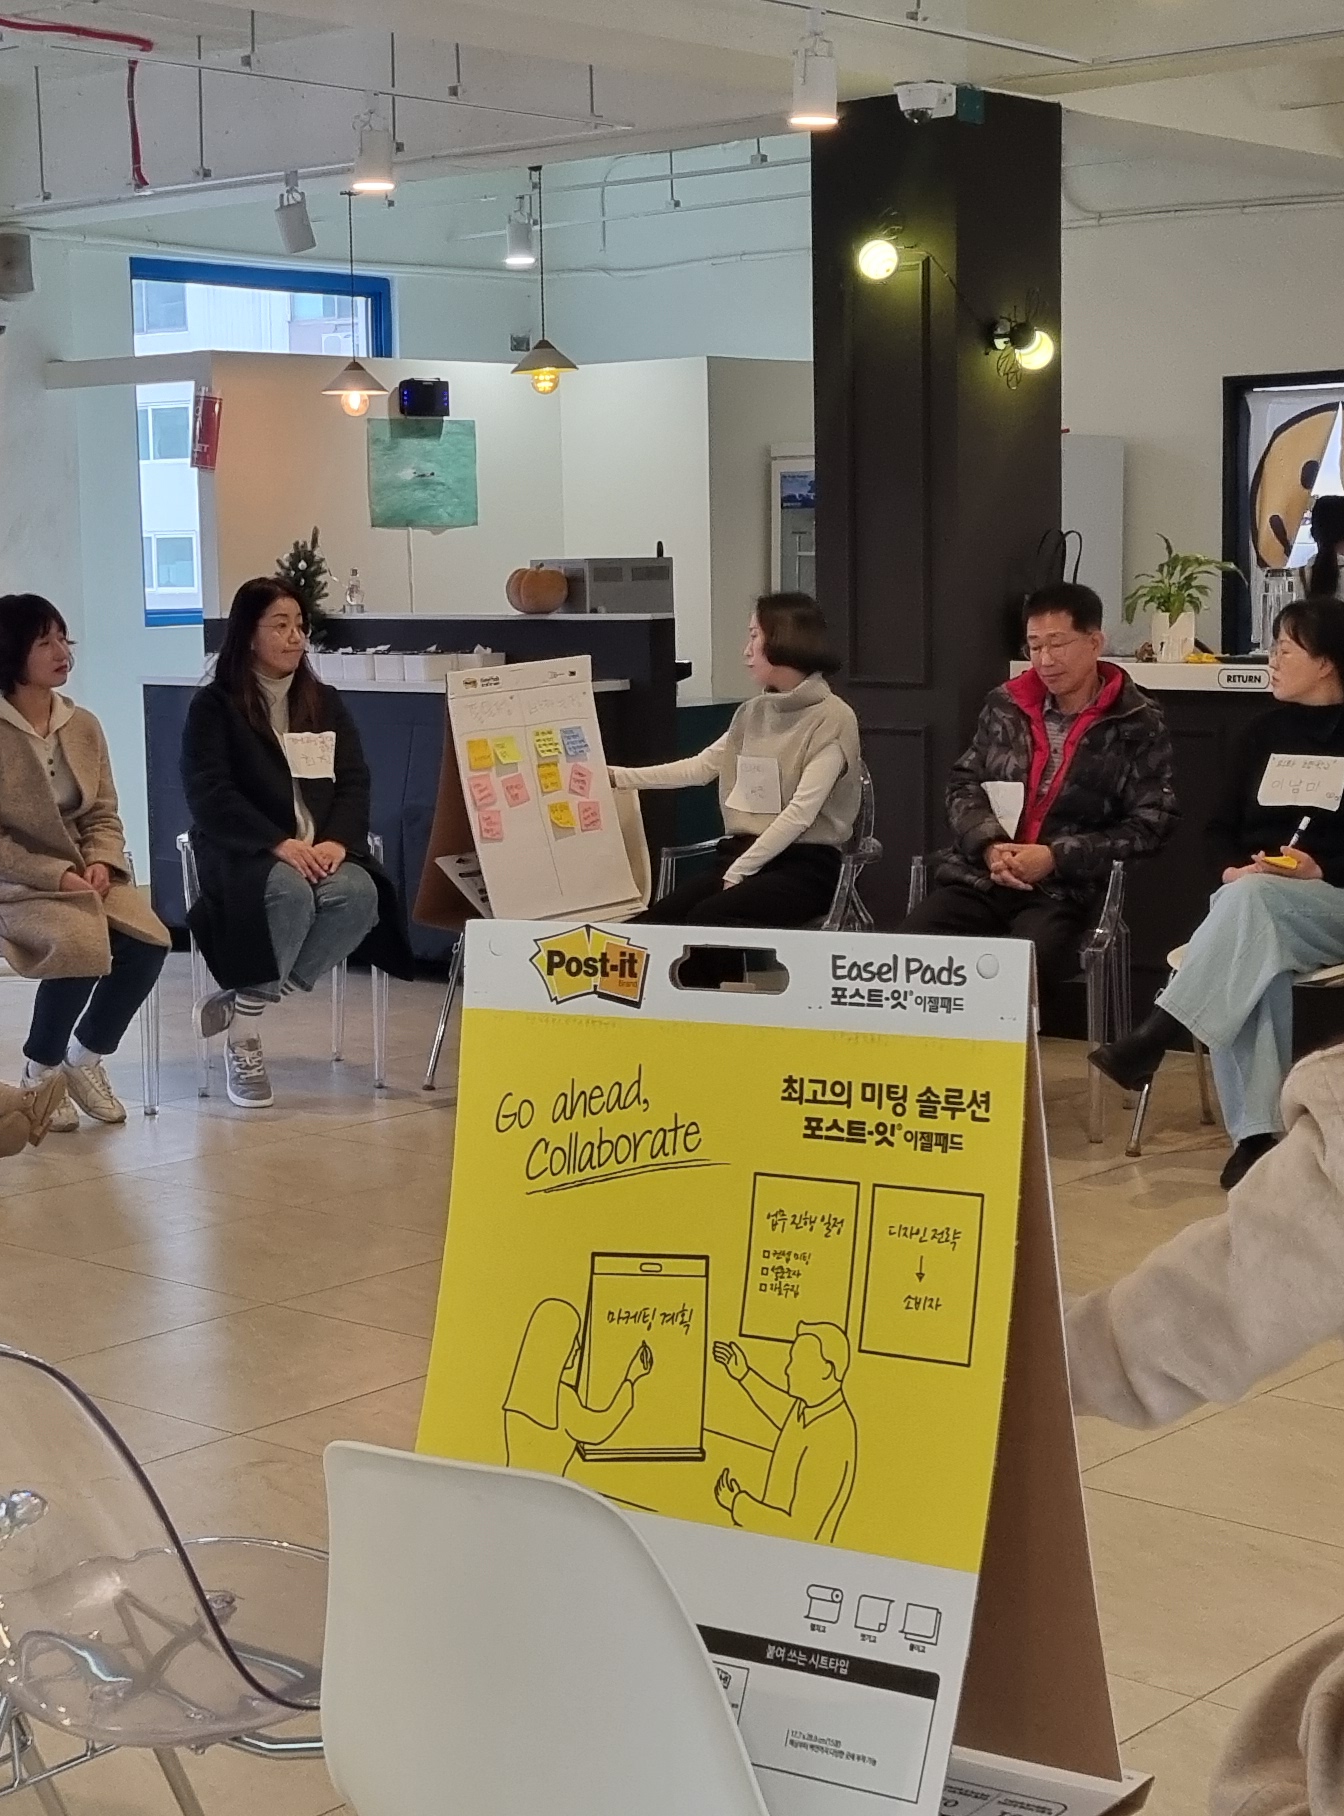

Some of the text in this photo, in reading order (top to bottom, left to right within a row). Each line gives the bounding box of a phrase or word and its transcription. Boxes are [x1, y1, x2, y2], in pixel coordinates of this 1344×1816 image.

[1227, 675, 1261, 683] RETURN
[547, 949, 638, 978] Post-it
[831, 954, 967, 986] Easel Pads
[495, 1063, 650, 1134] Go ahead,
[780, 1074, 991, 1123] 최고의 미팅 솔루션
[525, 1112, 703, 1181] Collaborate
[903, 1129, 964, 1154] 이젤패드
[766, 1208, 845, 1238] 업무 진행 일정
[888, 1223, 963, 1251] 디자인 전략
[903, 1294, 943, 1312] 소비자
[606, 1302, 694, 1336] 마케팅 계획
[766, 1643, 850, 1675] 붙여 쓰는 시트타입
